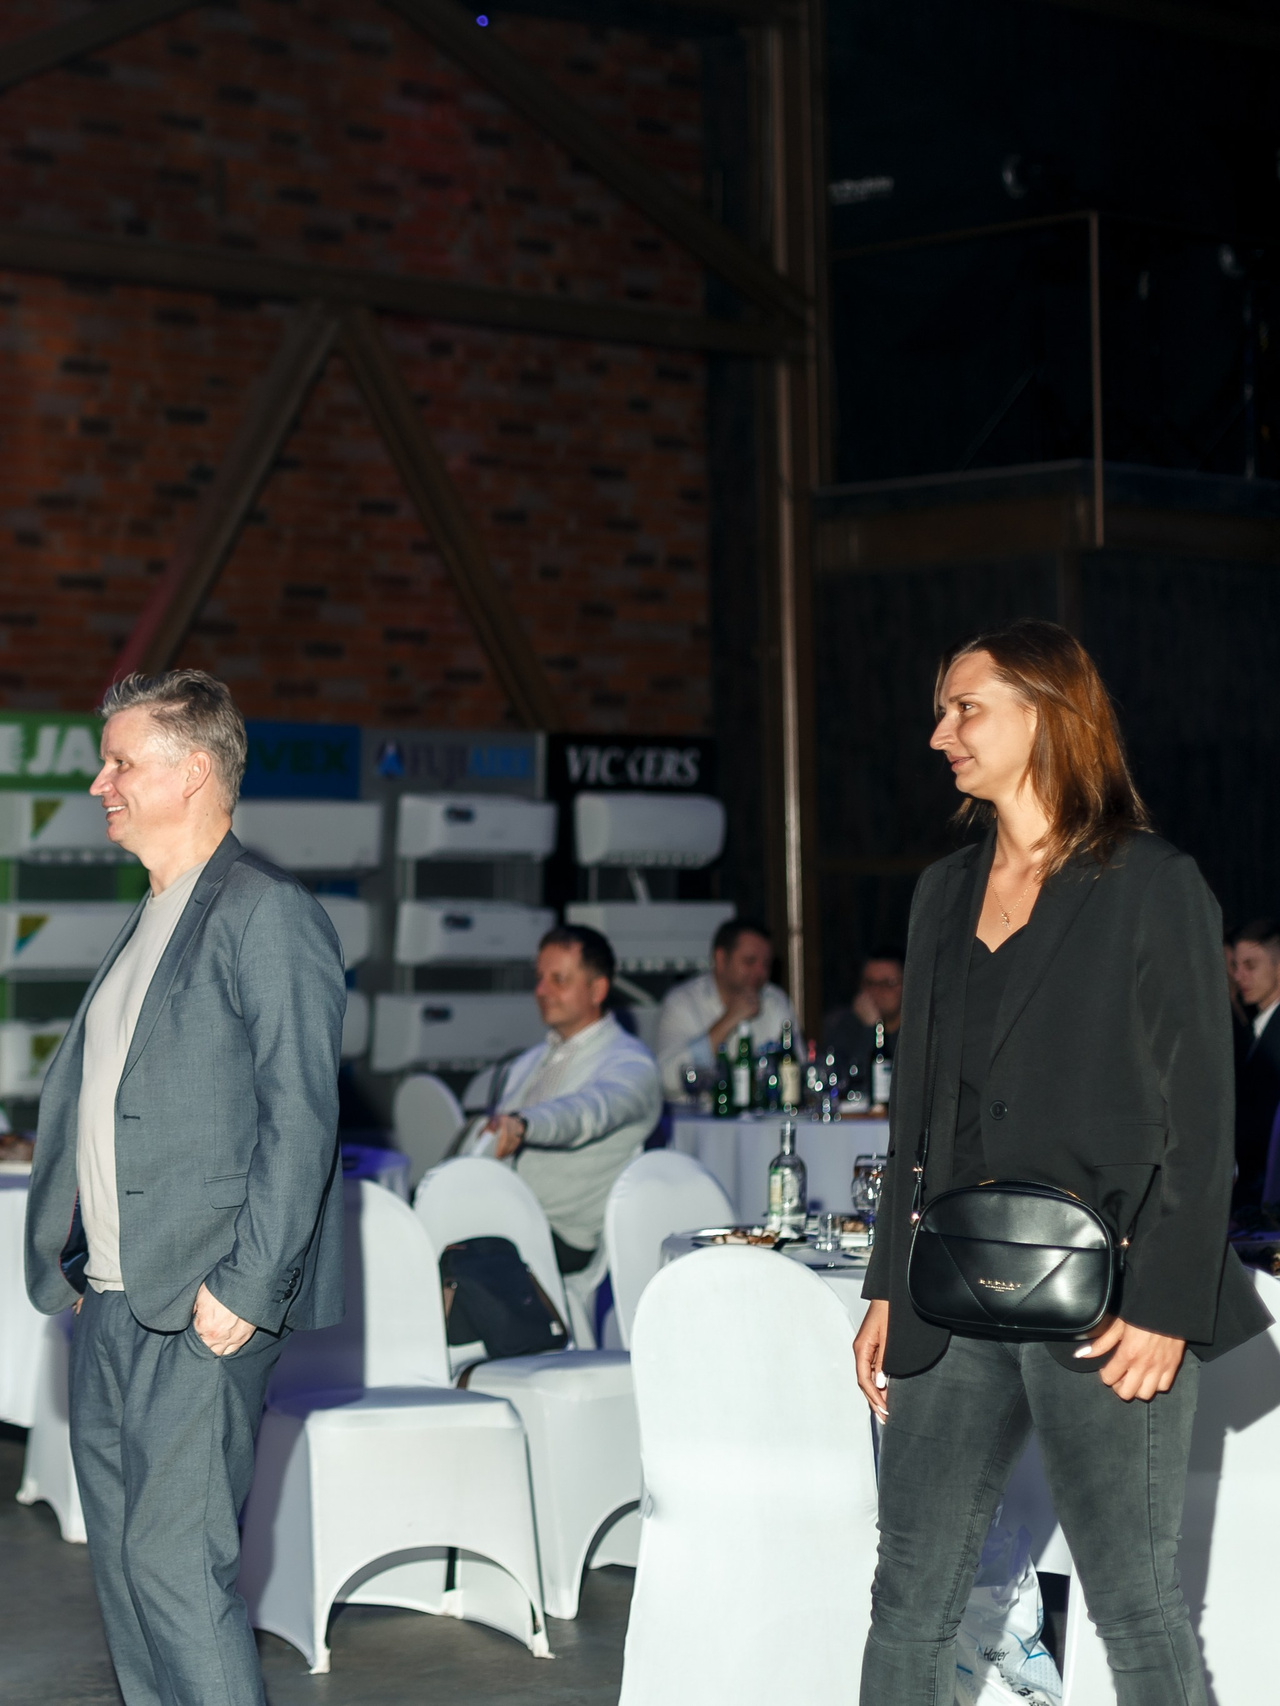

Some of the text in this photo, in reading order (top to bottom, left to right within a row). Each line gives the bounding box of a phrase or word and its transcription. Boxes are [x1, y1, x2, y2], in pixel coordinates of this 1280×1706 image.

[26, 724, 101, 776] JA
[245, 738, 349, 775] VEX
[565, 744, 701, 787] VICKERS
[983, 1647, 1010, 1661] Haier
